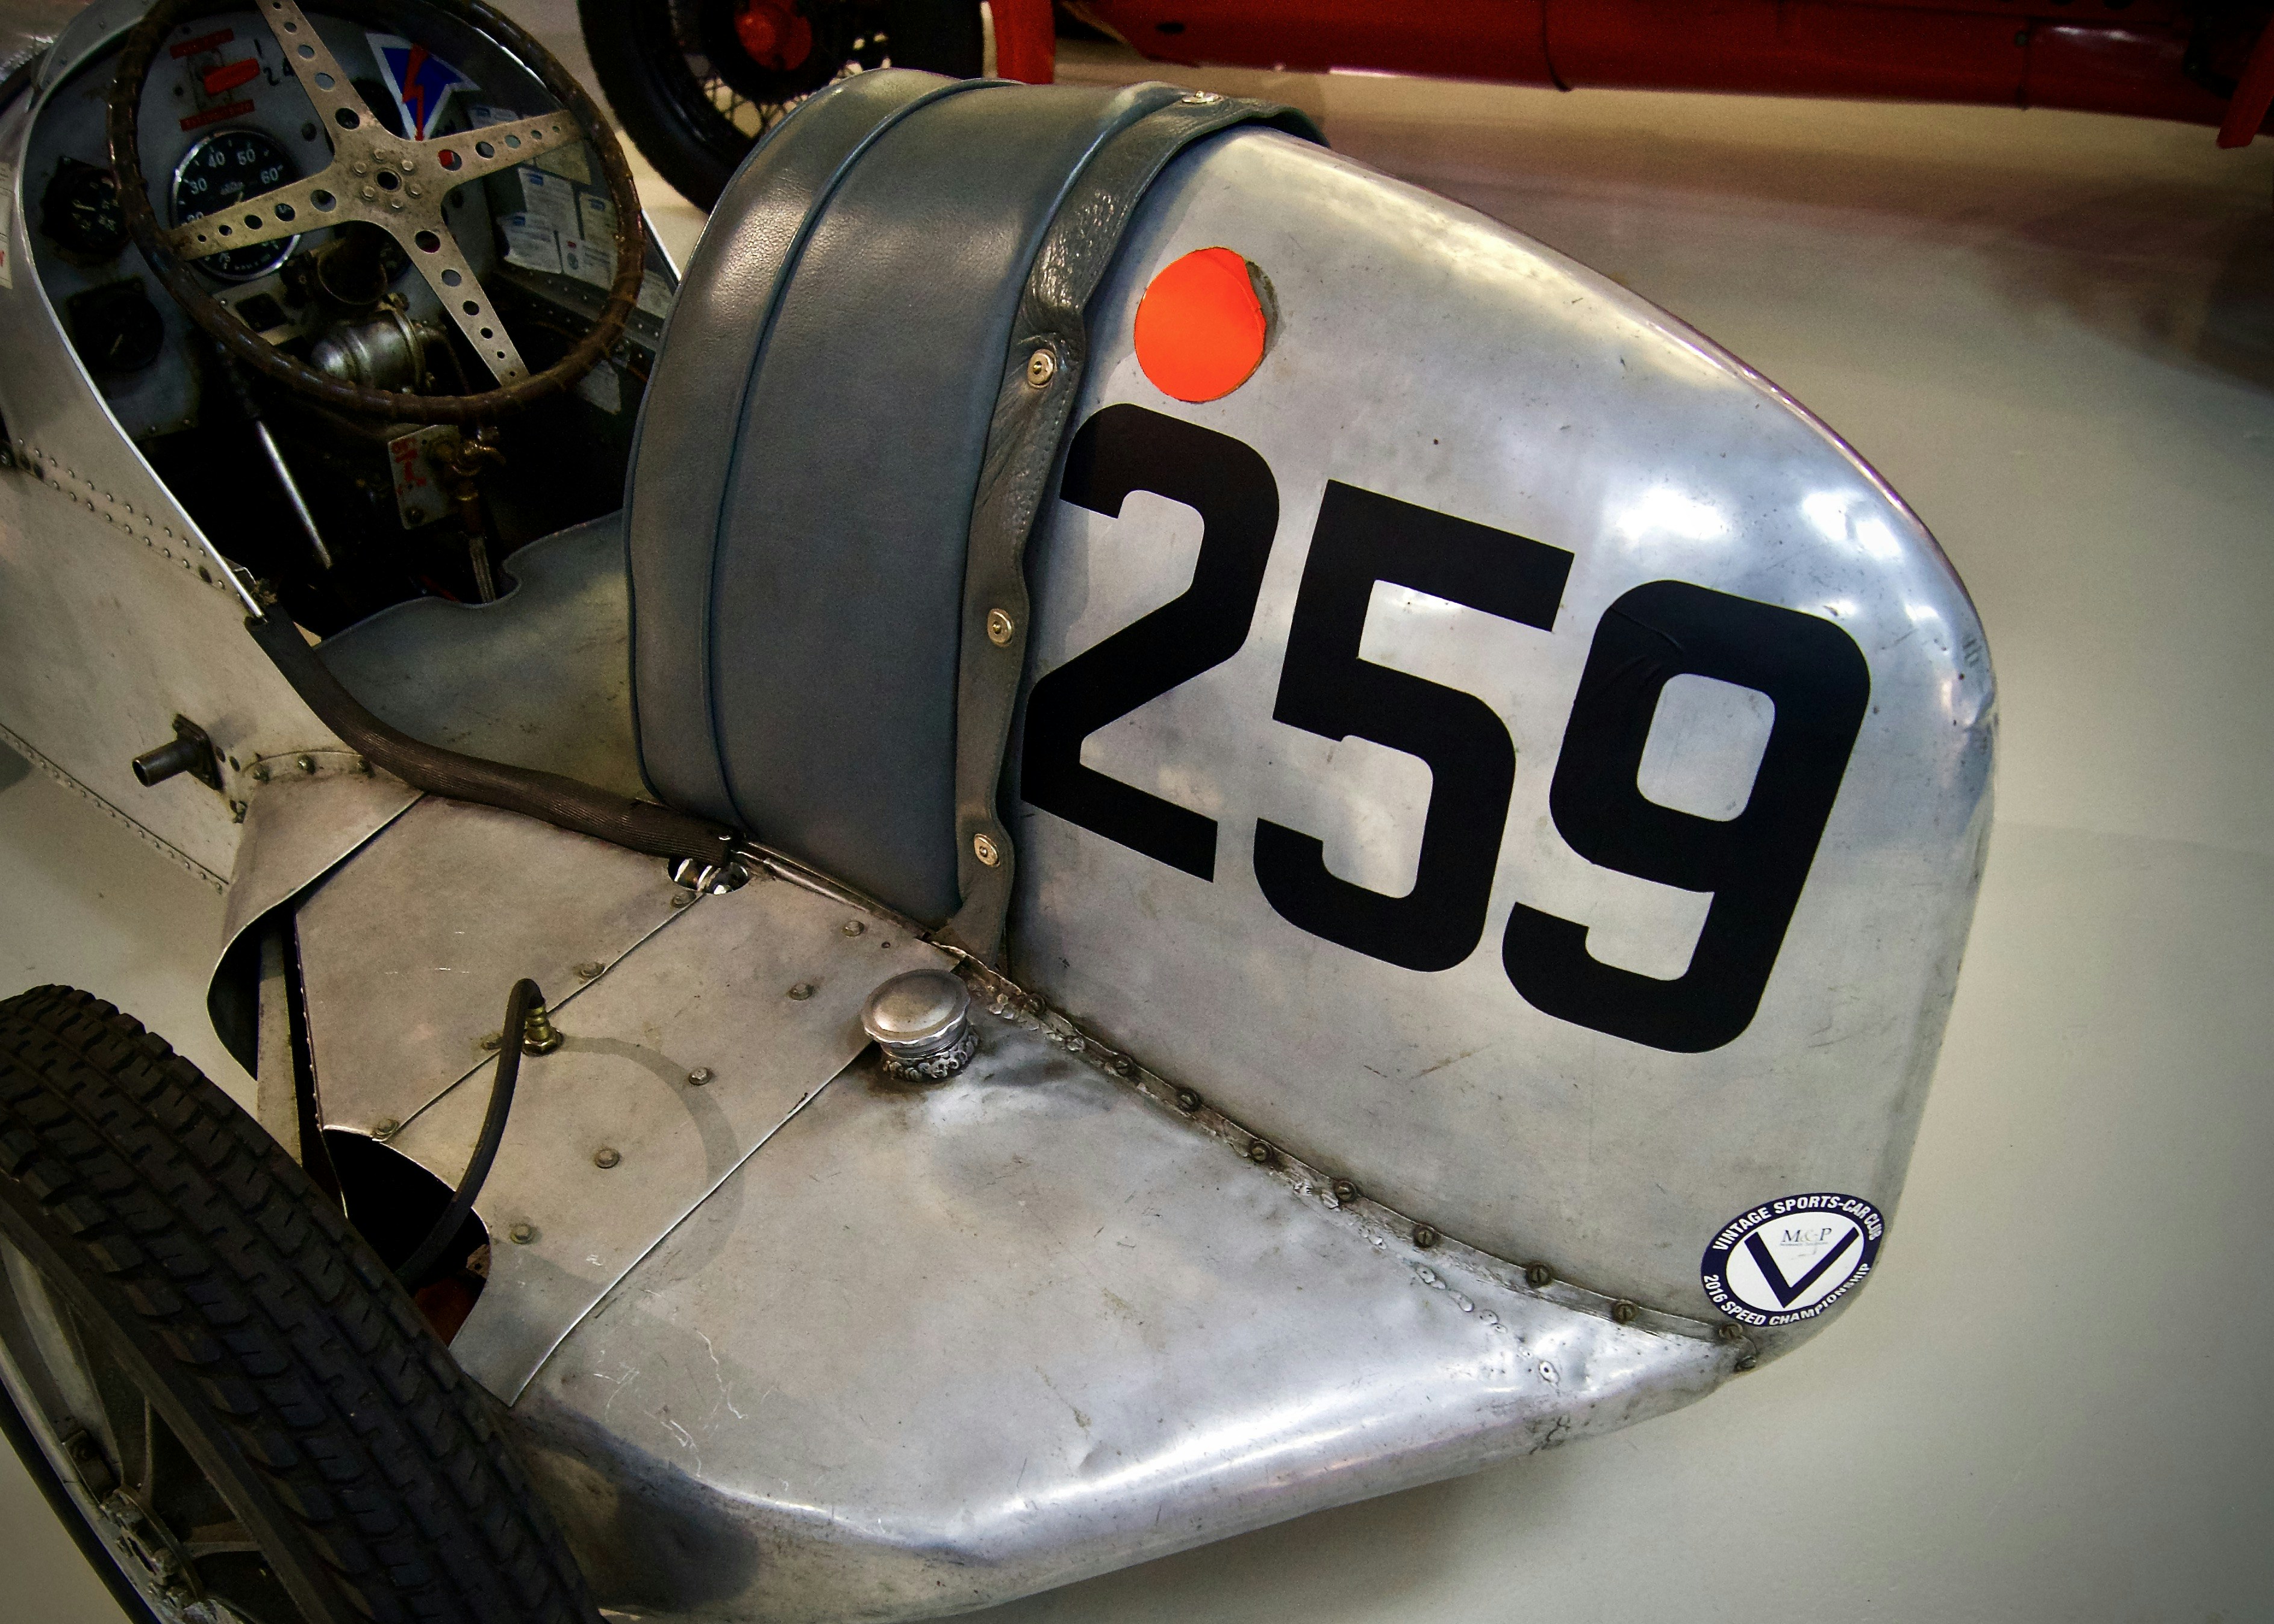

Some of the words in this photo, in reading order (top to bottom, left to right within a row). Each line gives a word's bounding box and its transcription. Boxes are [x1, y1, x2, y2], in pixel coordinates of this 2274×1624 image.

[208, 151, 226, 168] 40
[1021, 402, 1871, 1054] 259
[1713, 1207, 1772, 1251] VINTAGE
[1773, 1195, 1870, 1219] SPORTS-CAR
[1864, 1212, 1883, 1241] CLUB
[1703, 1274, 1728, 1303] 2016
[1721, 1301, 1766, 1325] SPEED
[1768, 1263, 1871, 1326] CHAMPIONSHIP
